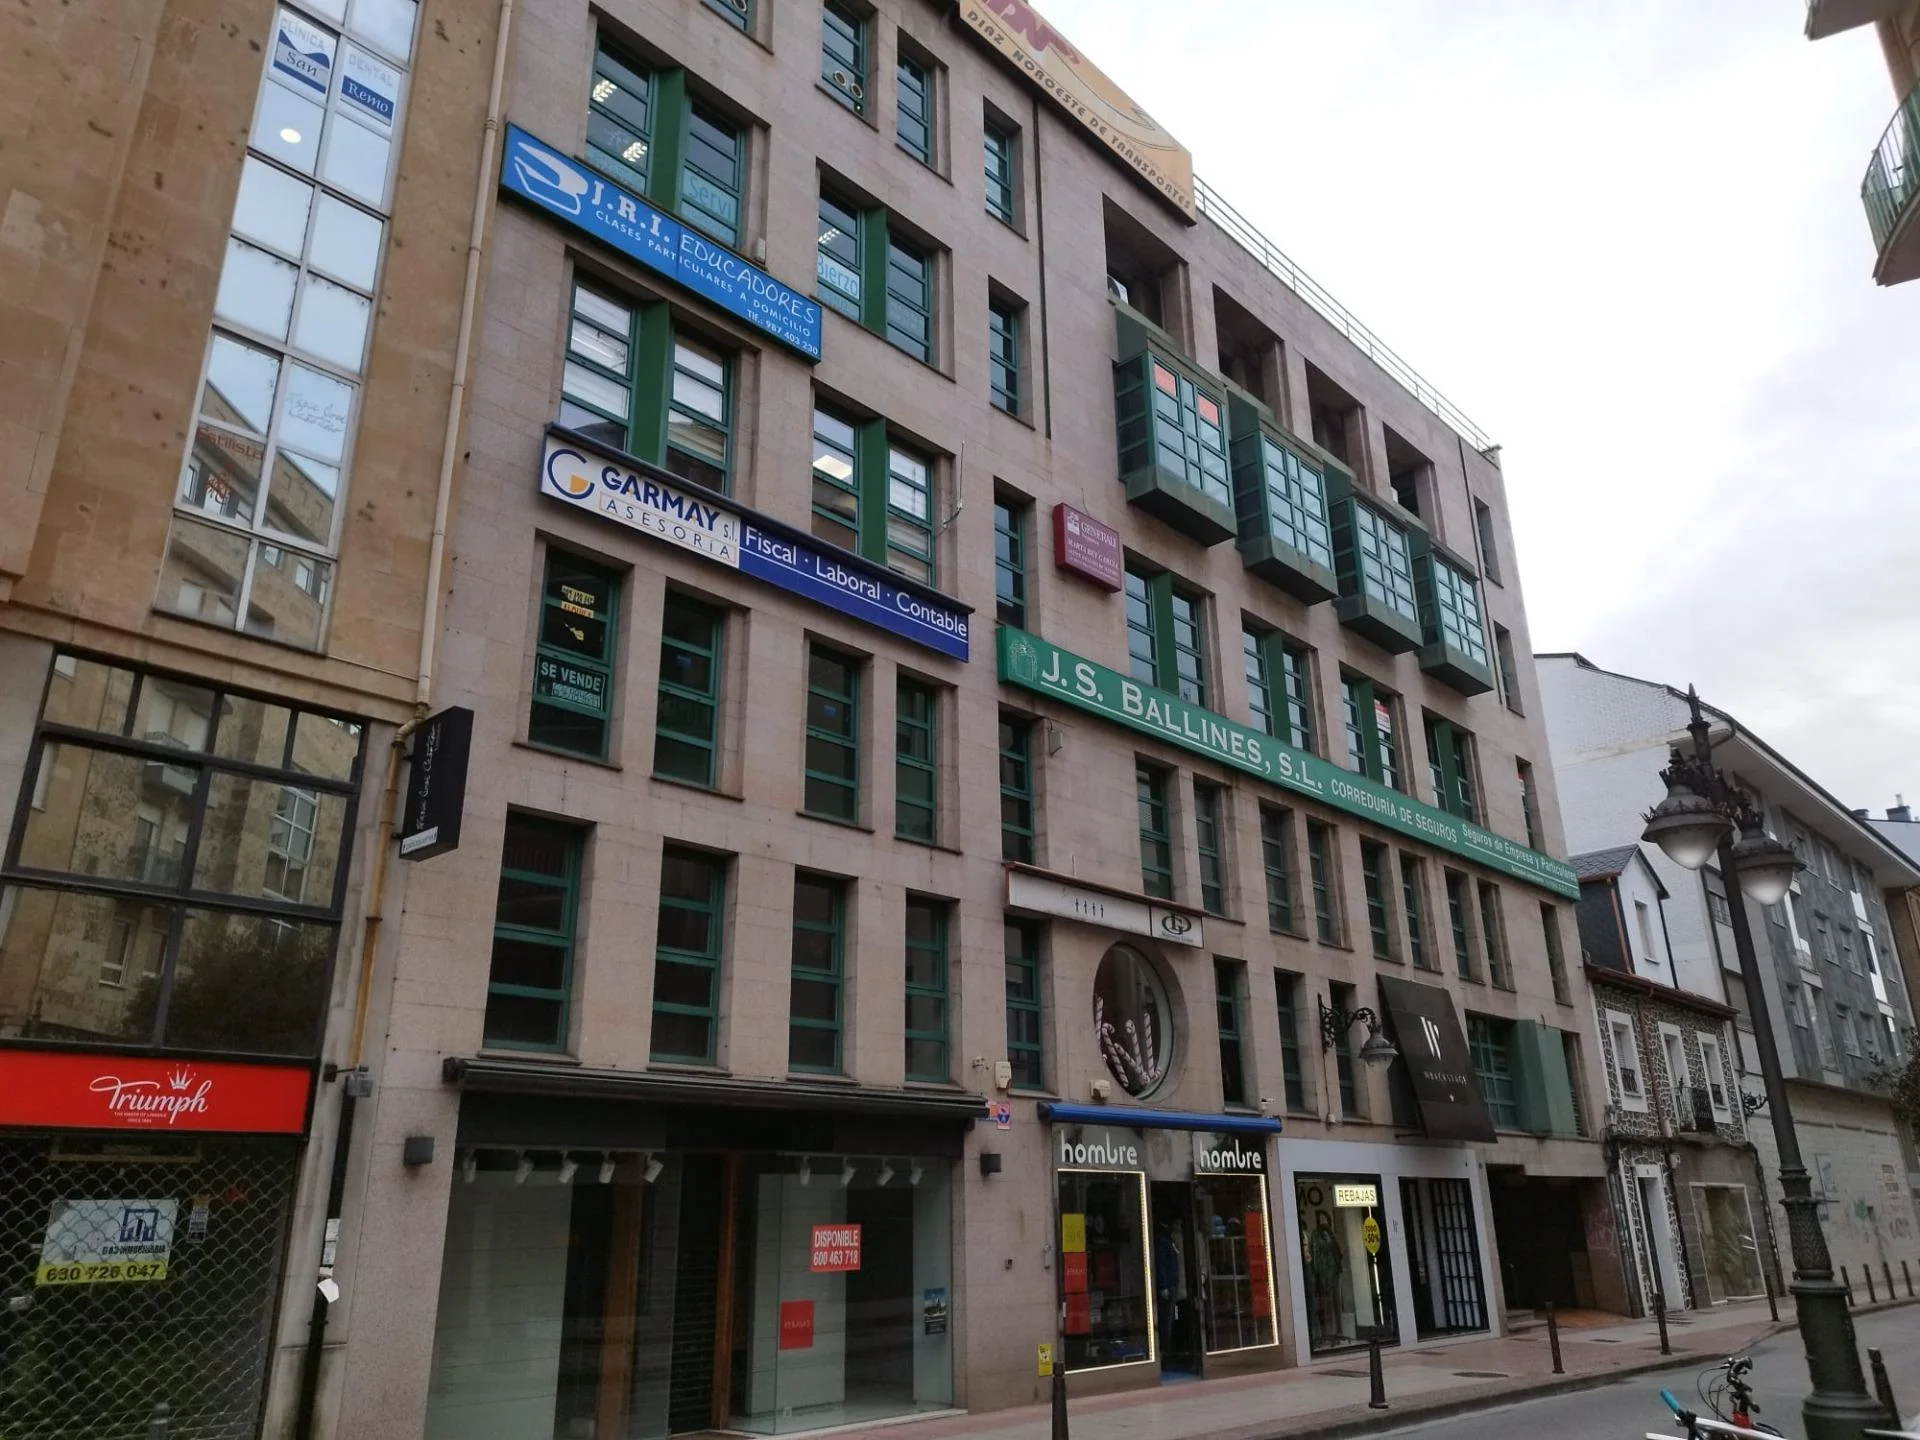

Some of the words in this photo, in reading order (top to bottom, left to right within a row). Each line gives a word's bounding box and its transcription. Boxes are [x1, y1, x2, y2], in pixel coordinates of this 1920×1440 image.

[287, 52, 317, 77] San
[348, 82, 389, 113] Remo
[967, 10, 1004, 45] DIAZ
[1012, 50, 1086, 116] NOROESTE
[1089, 117, 1107, 136] DE
[1111, 135, 1191, 210] TRANSPORTES
[595, 210, 641, 241] CLASES
[648, 240, 733, 293] PARTICULARES
[739, 292, 747, 302] A
[753, 300, 810, 337] DOMICILIO
[681, 234, 815, 324] EDUCADORES
[765, 319, 782, 336] 987
[601, 466, 720, 531] GARMAY
[745, 527, 797, 565] Fiscal
[816, 555, 880, 600] Laboral
[896, 592, 967, 637] Contable
[540, 661, 557, 678] SE
[561, 667, 601, 691] VENDE
[1278, 753, 1322, 789] S.L.
[1400, 807, 1412, 825] DE
[1416, 814, 1457, 844] SEGUROS
[1462, 824, 1492, 847] Seguros
[1493, 836, 1503, 851] de
[1504, 840, 1534, 865] Empresa
[1534, 856, 1539, 869] y
[89, 1076, 213, 1125] Triumph
[1060, 1129, 1138, 1165] hombre
[1200, 1139, 1262, 1169] hombre
[1338, 1189, 1375, 1202] REBAJAS
[814, 1229, 859, 1248] DISPONIBLE
[46, 1267, 80, 1282] 630
[127, 1264, 160, 1278] 047
[813, 1251, 827, 1266] 600
[829, 1251, 842, 1265] 463
[844, 1250, 858, 1264] 718
